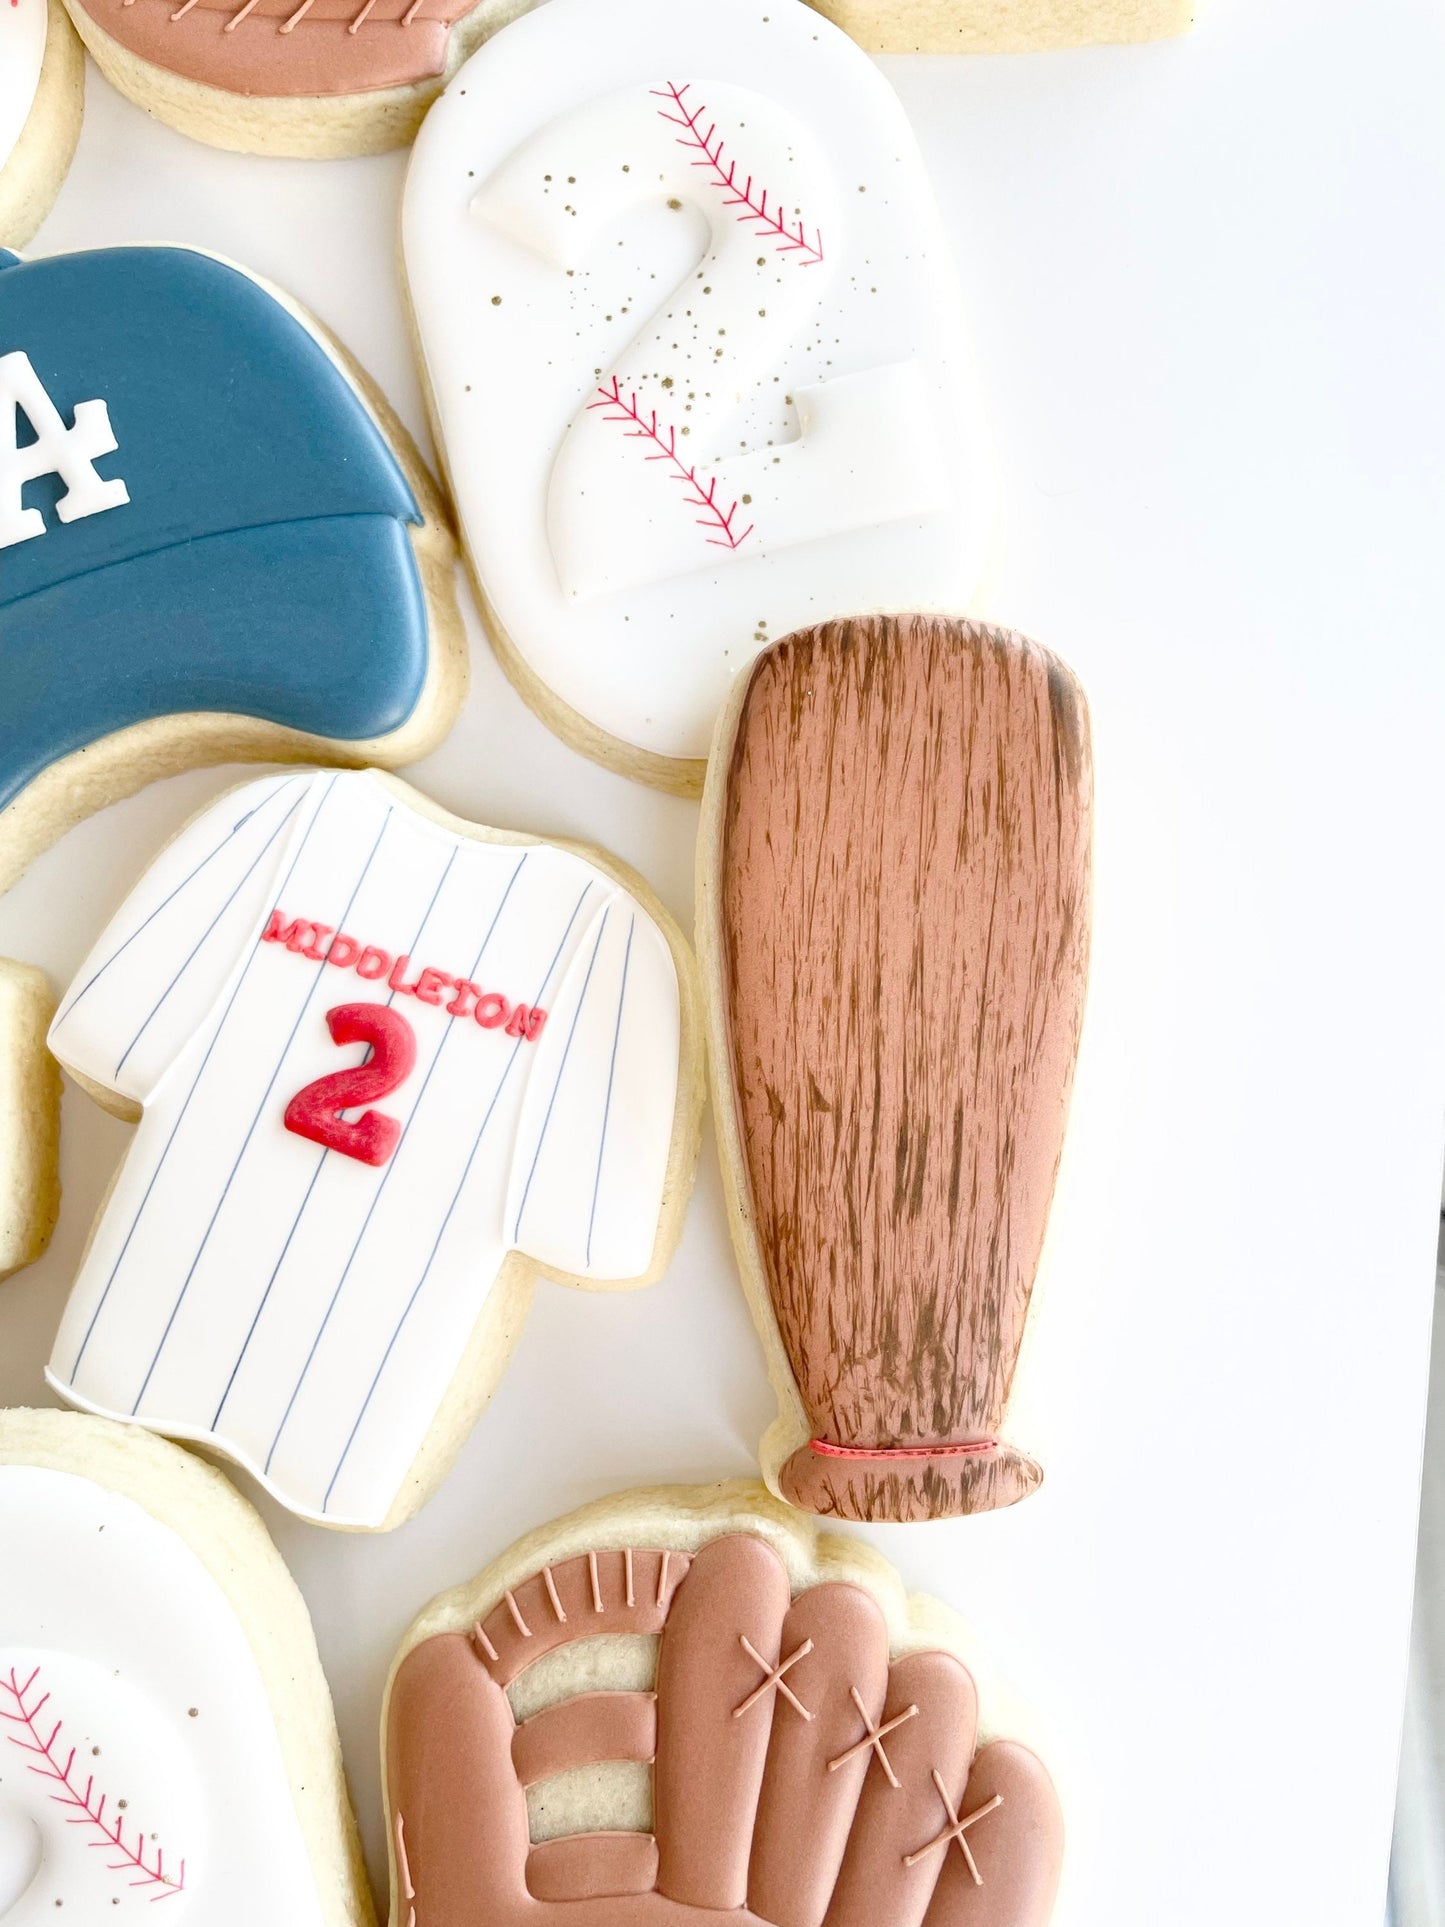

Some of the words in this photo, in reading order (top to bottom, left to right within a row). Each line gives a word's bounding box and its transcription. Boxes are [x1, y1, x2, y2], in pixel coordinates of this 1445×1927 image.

[468, 78, 952, 606] 2
[260, 908, 548, 1042] MIDDLETON
[283, 1002, 417, 1168] 2
